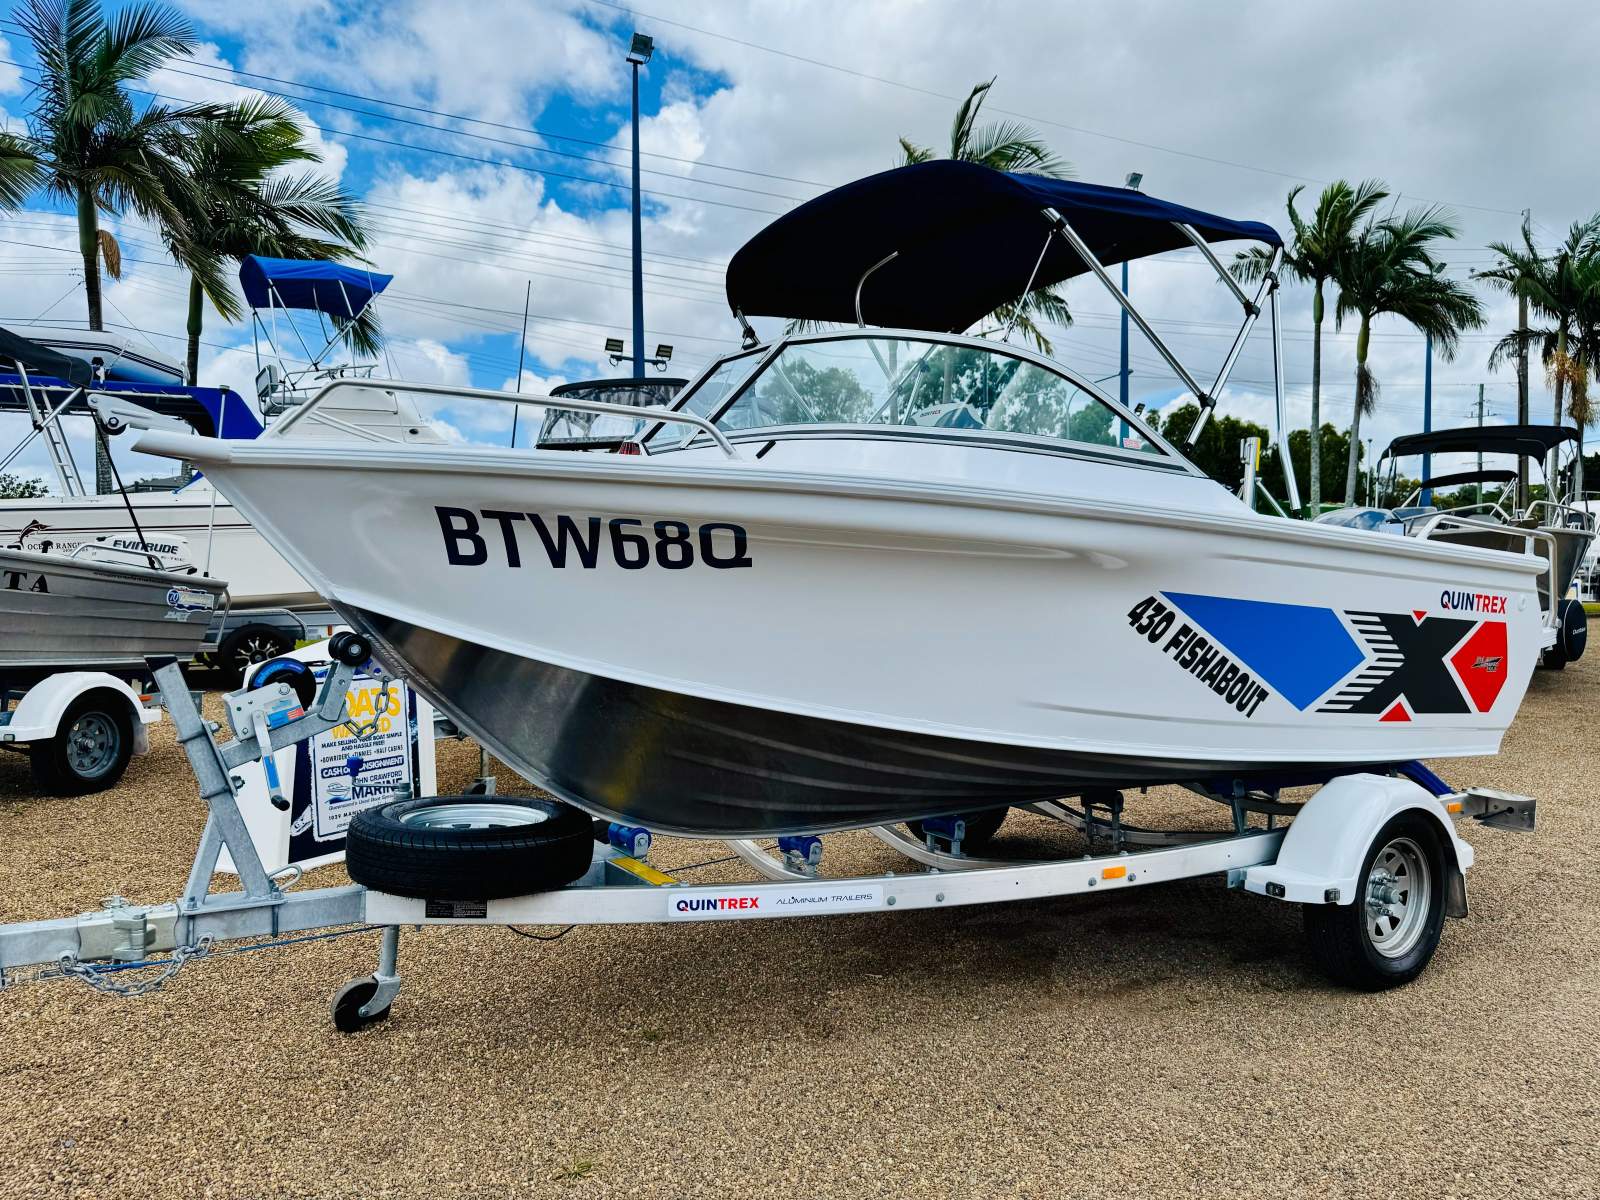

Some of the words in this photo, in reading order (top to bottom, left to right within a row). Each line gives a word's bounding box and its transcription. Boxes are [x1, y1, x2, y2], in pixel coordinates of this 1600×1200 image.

[434, 506, 752, 569] BTW68Q
[1441, 590, 1507, 614] QUINTREX
[1127, 596, 1176, 643] 430
[1162, 623, 1270, 719] FISHABOUT
[321, 741, 336, 749] MAKE
[337, 738, 358, 746] SELLING
[323, 767, 343, 777] CASH
[359, 757, 403, 771] NSIGNMENT
[370, 770, 402, 781] CRAWFORD
[677, 897, 759, 912] QUINTREX
[776, 896, 827, 905] ALUMINIUM
[831, 893, 872, 902] TRAILERS
